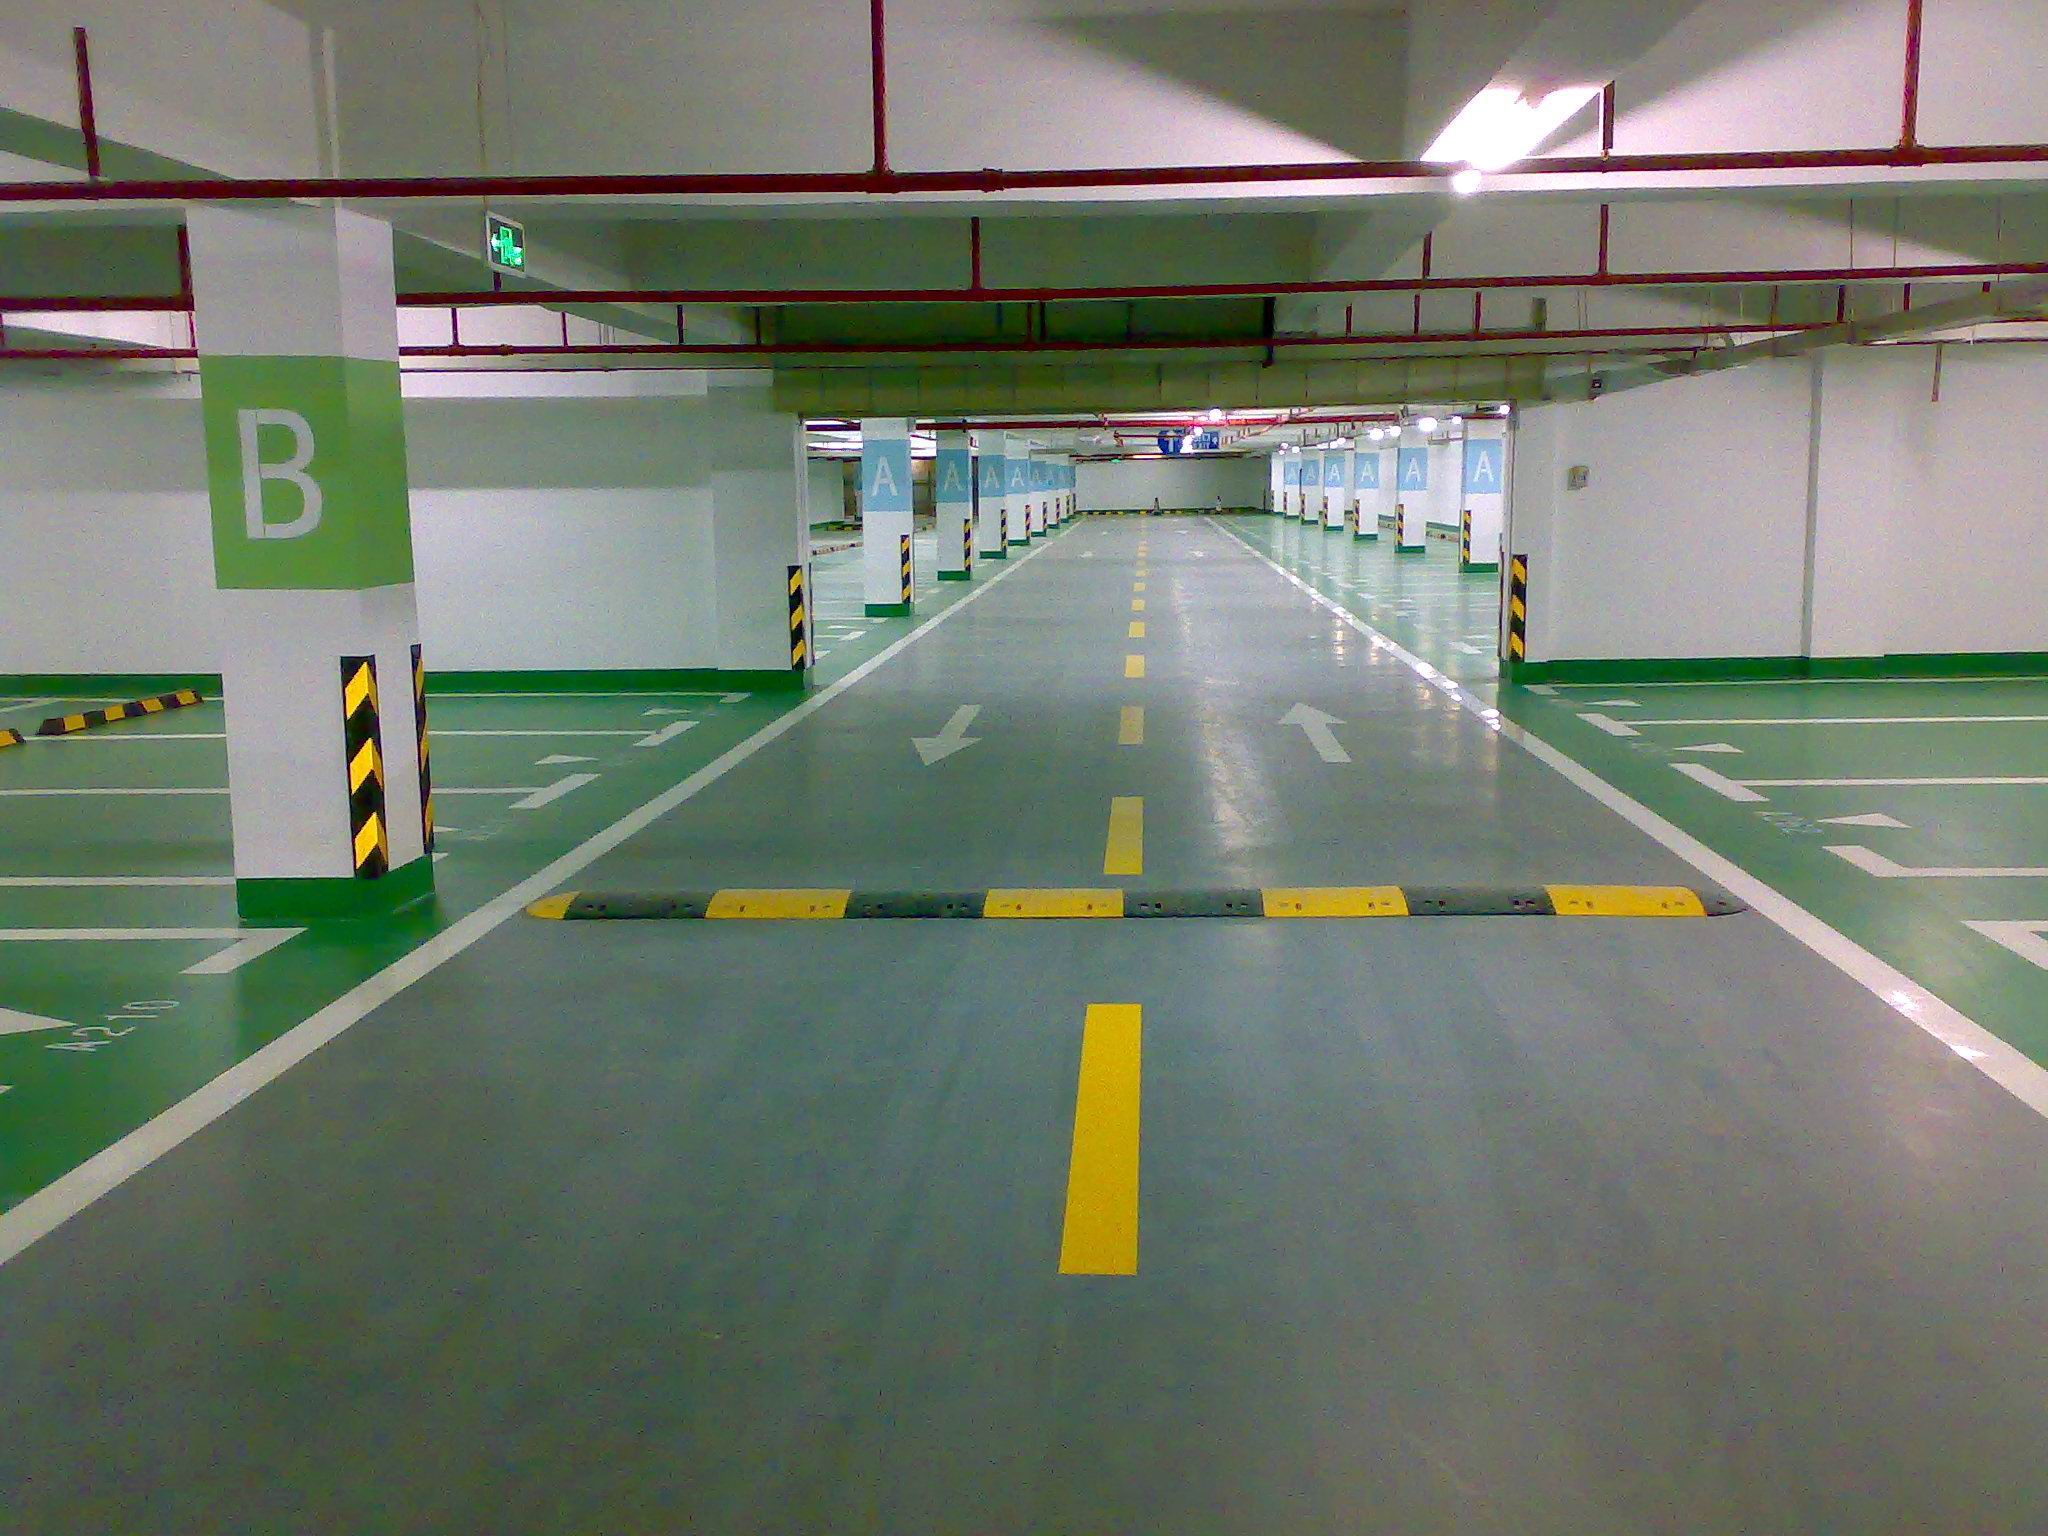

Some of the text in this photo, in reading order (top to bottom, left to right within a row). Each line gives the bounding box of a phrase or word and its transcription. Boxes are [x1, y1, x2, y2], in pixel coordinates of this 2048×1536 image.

[238, 408, 322, 540] B
[870, 455, 898, 497] A
[944, 460, 962, 491] A
[984, 465, 1000, 489] A
[1011, 466, 1025, 487] A
[1330, 463, 1341, 481] A
[1360, 461, 1375, 482] A
[1405, 457, 1421, 482] A
[1473, 450, 1494, 482] A
